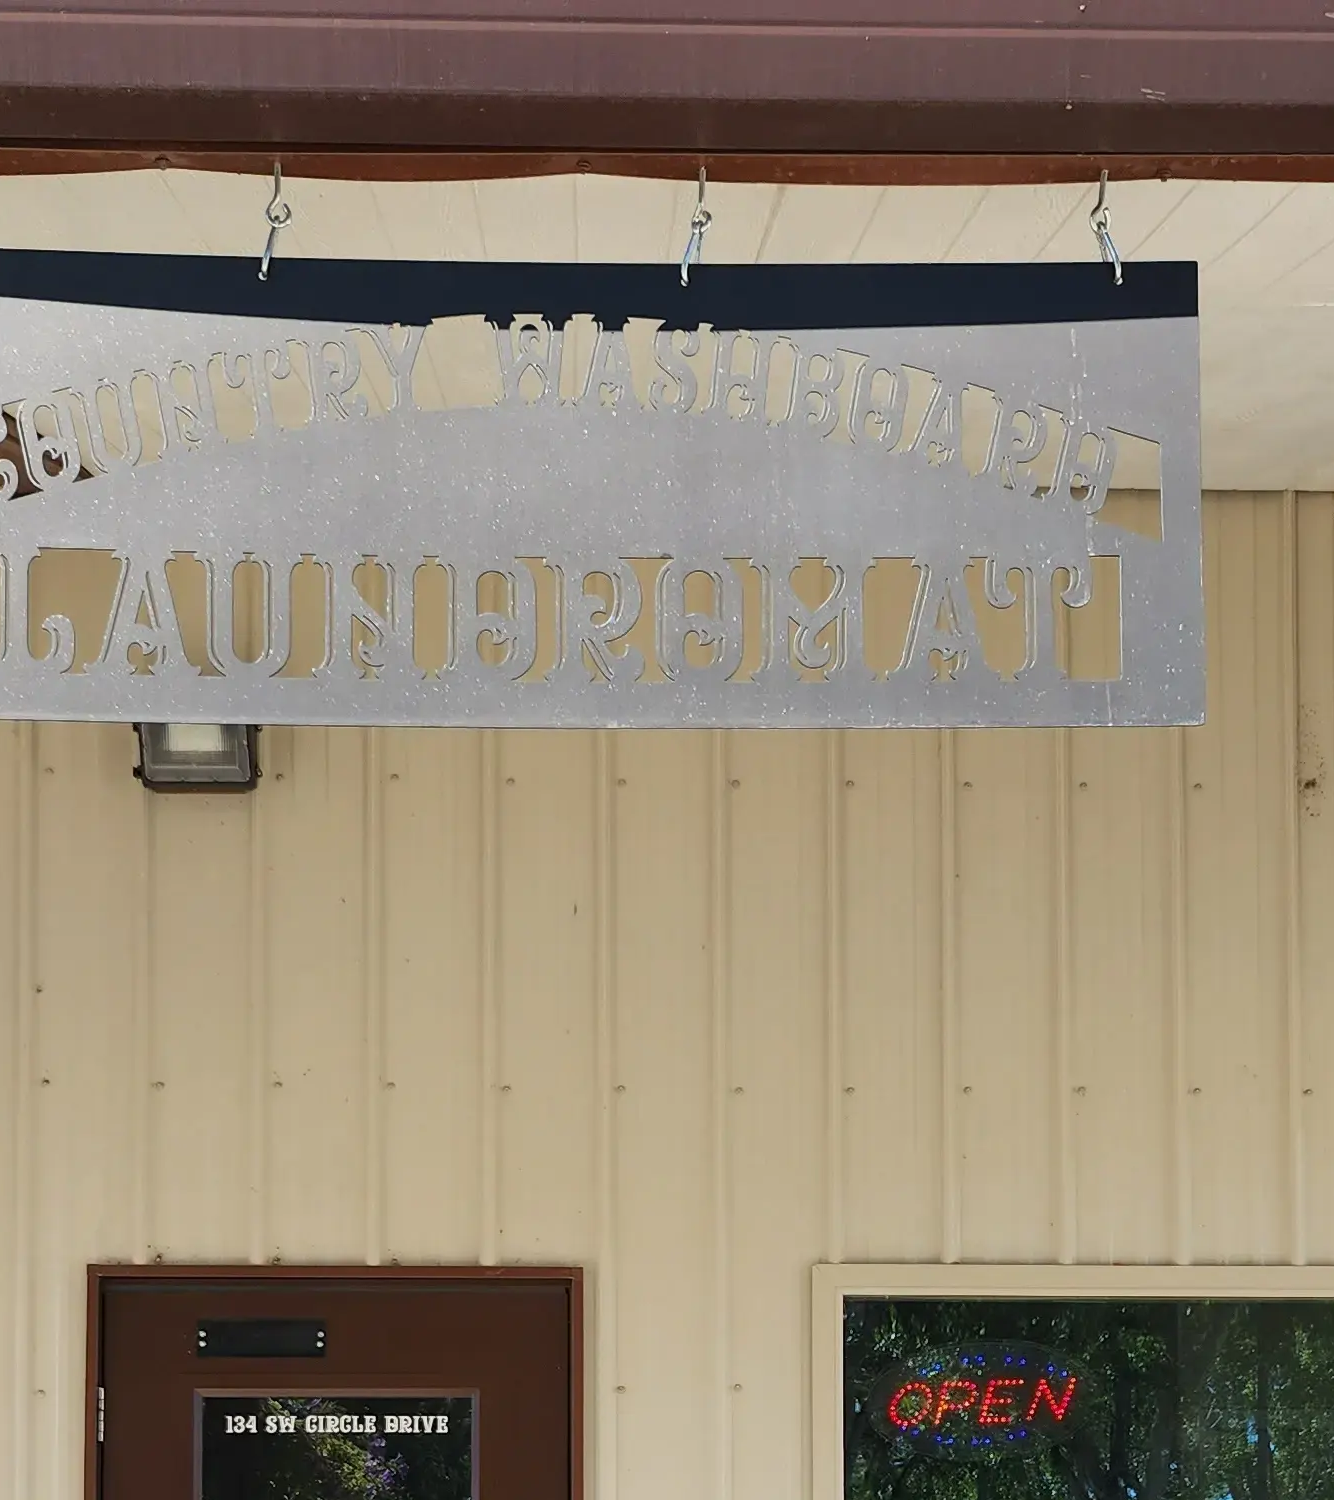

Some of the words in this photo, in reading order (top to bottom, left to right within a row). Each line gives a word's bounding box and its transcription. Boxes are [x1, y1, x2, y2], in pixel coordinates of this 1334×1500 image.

[487, 314, 1120, 515] WASHBOARD
[225, 1415, 258, 1434] 134
[265, 1415, 297, 1434] SW
[305, 1415, 377, 1434] CIRCLE
[383, 1415, 450, 1434] DRIVE
[889, 1376, 1076, 1427] OPEN
